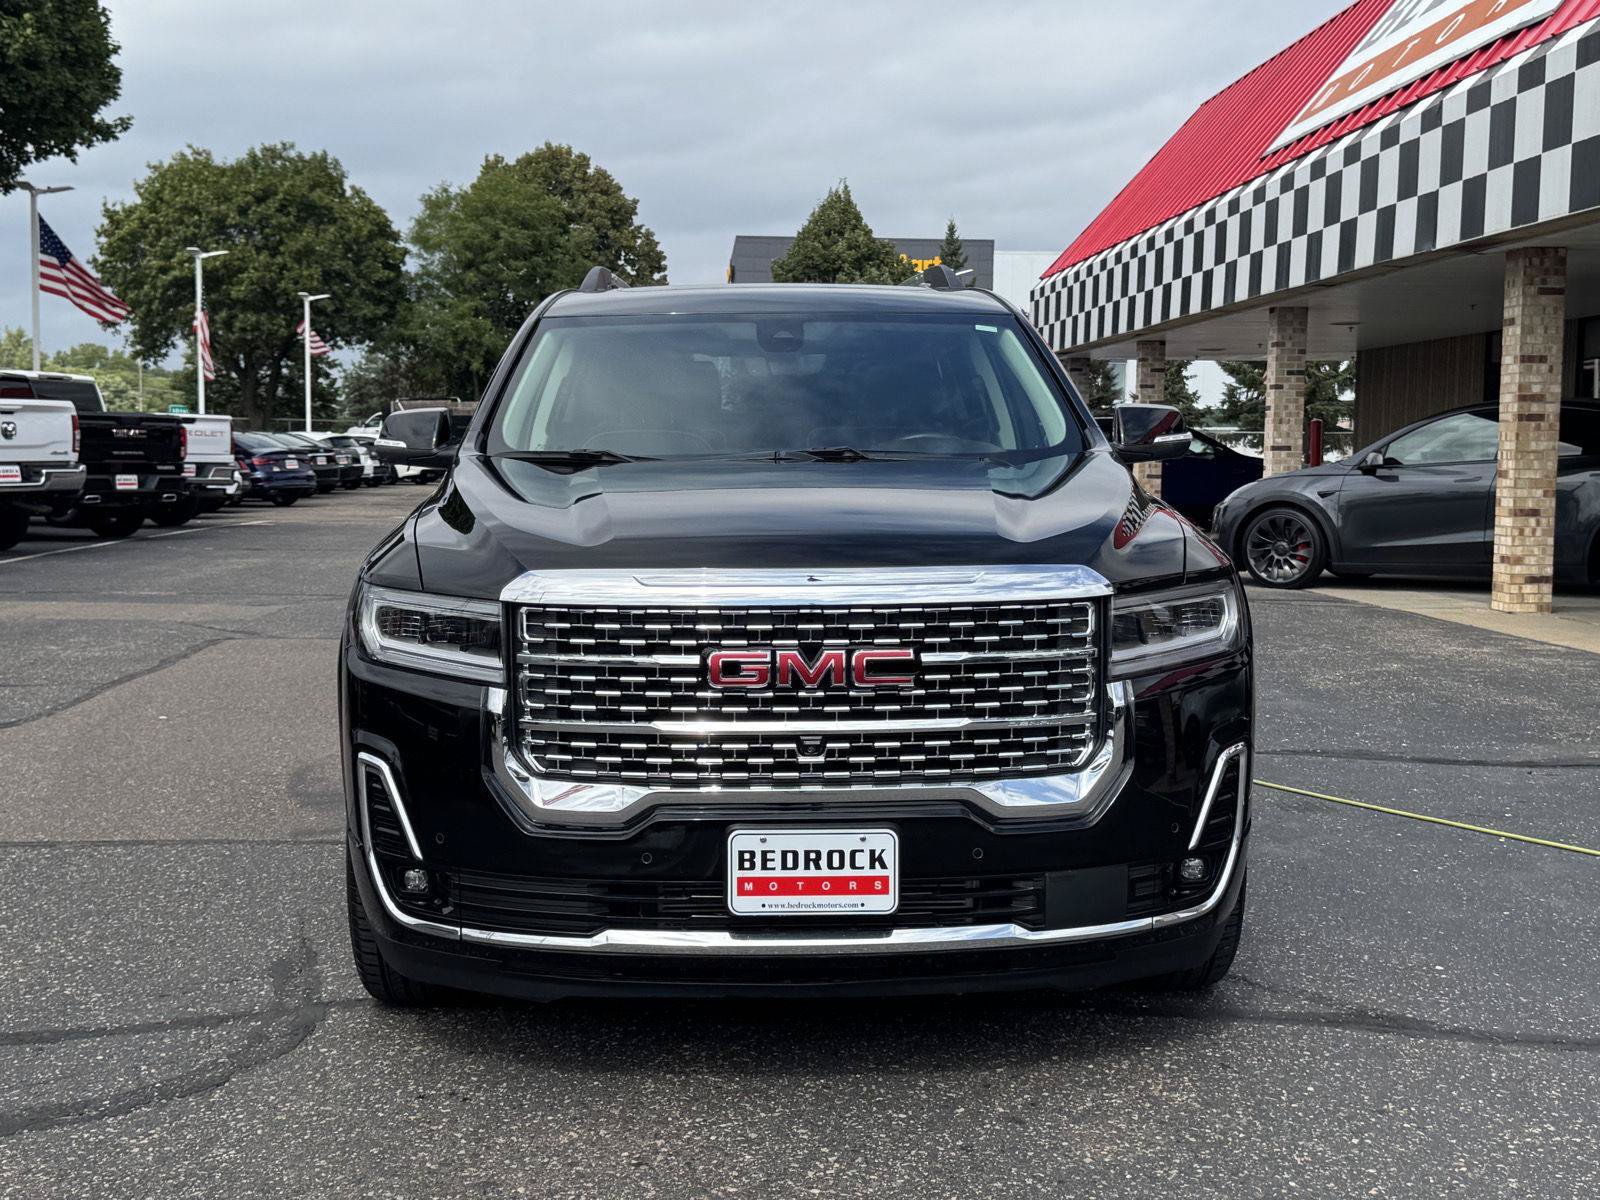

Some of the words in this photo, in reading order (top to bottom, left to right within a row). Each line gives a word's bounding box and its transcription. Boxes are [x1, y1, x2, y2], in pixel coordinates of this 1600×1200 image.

[708, 649, 915, 689] GMC
[737, 849, 889, 871] BEDROCK
[744, 880, 882, 891] MOTORS
